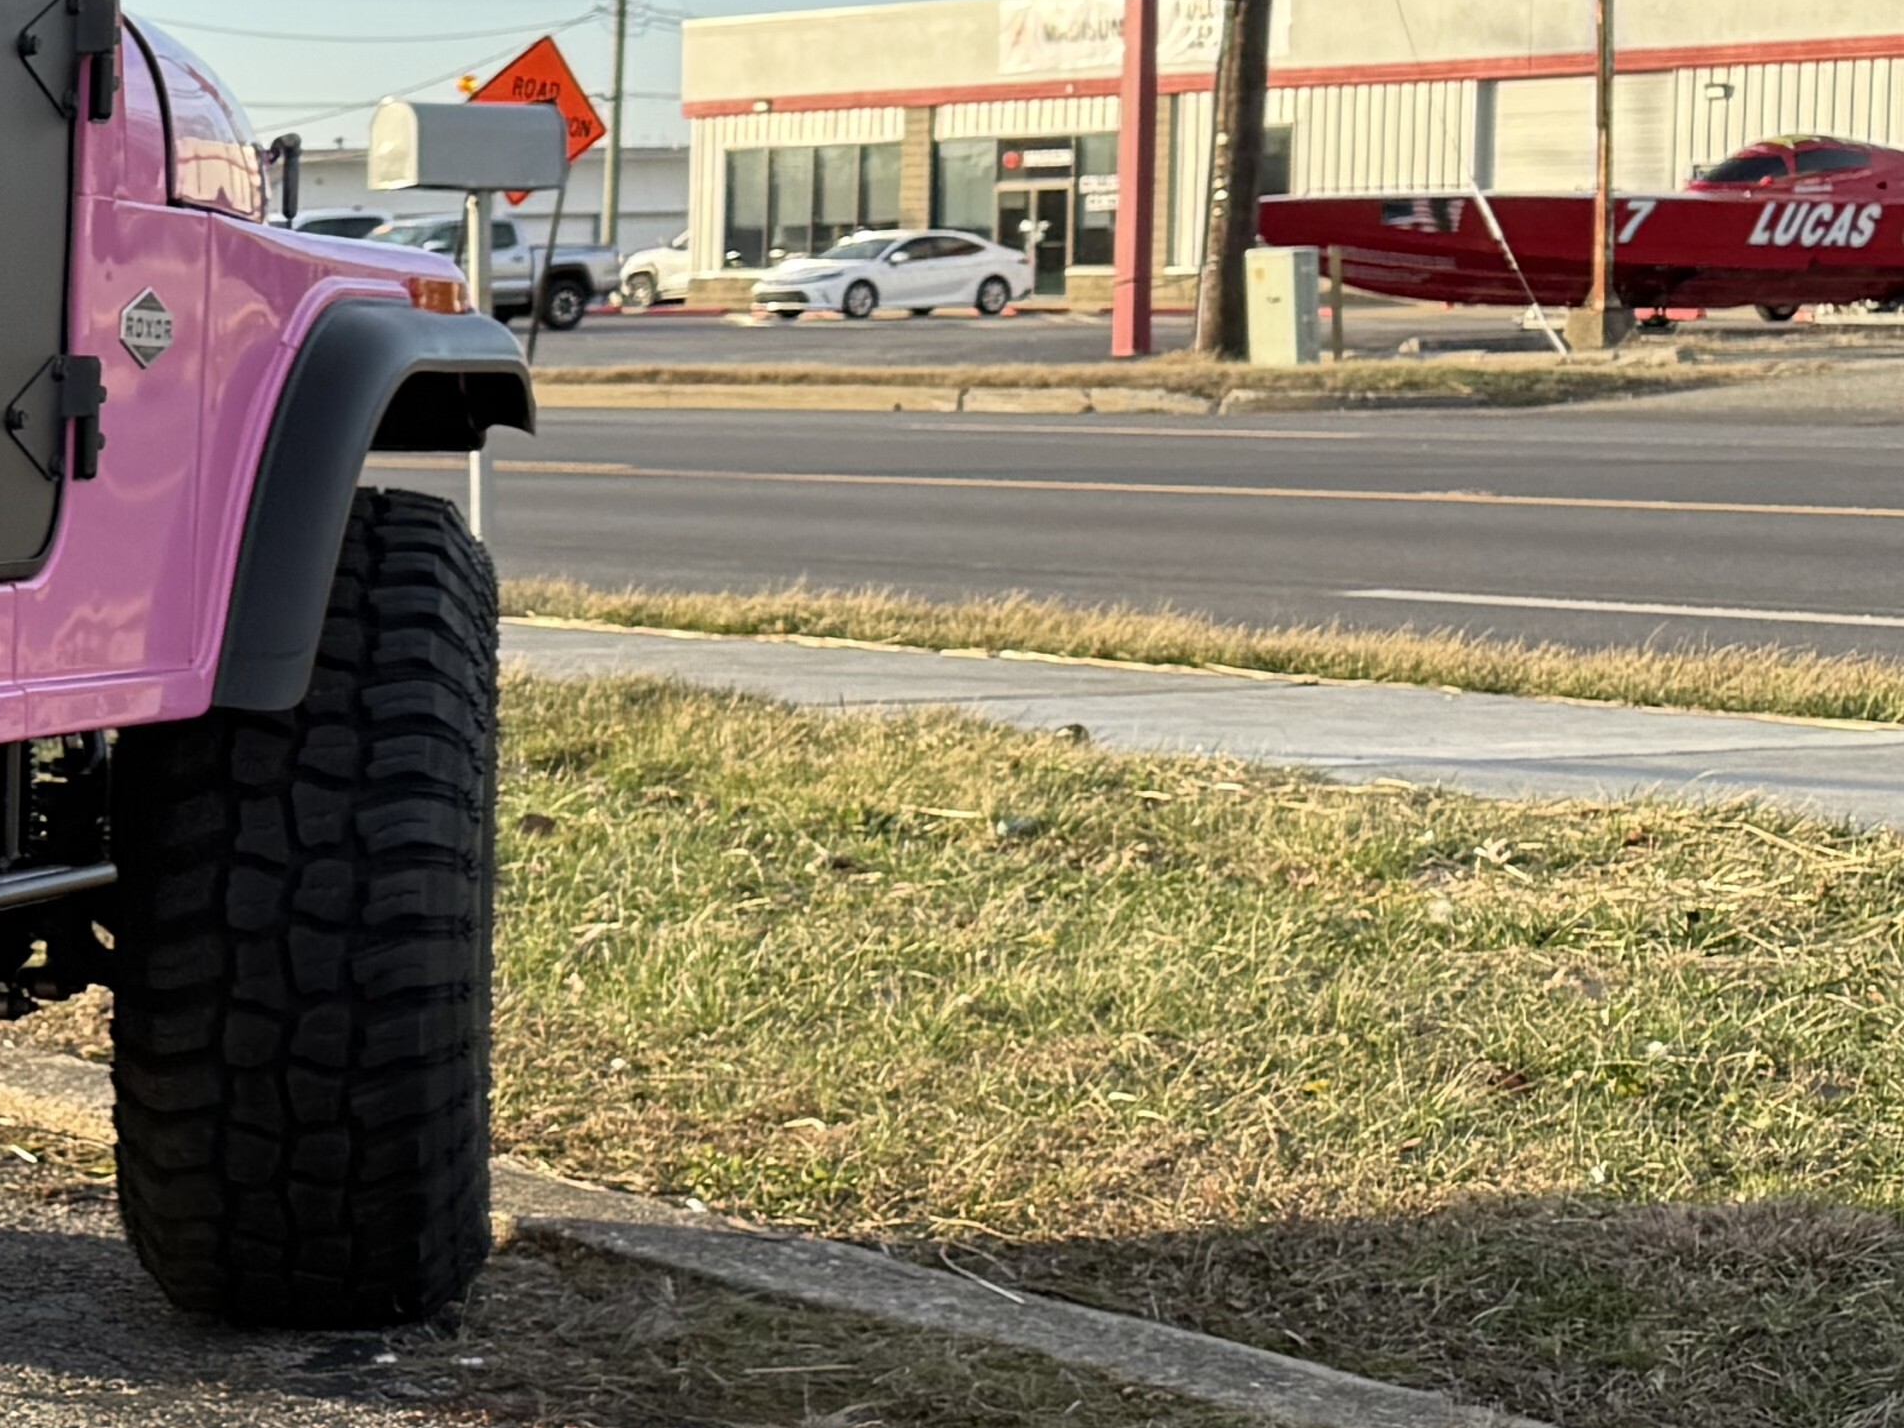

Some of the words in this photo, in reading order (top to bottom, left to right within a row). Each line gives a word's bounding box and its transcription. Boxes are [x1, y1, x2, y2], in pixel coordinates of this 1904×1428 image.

[512, 75, 561, 99] ROAD
[1746, 201, 1883, 248] LUCAS
[126, 316, 172, 340] ROXOR
